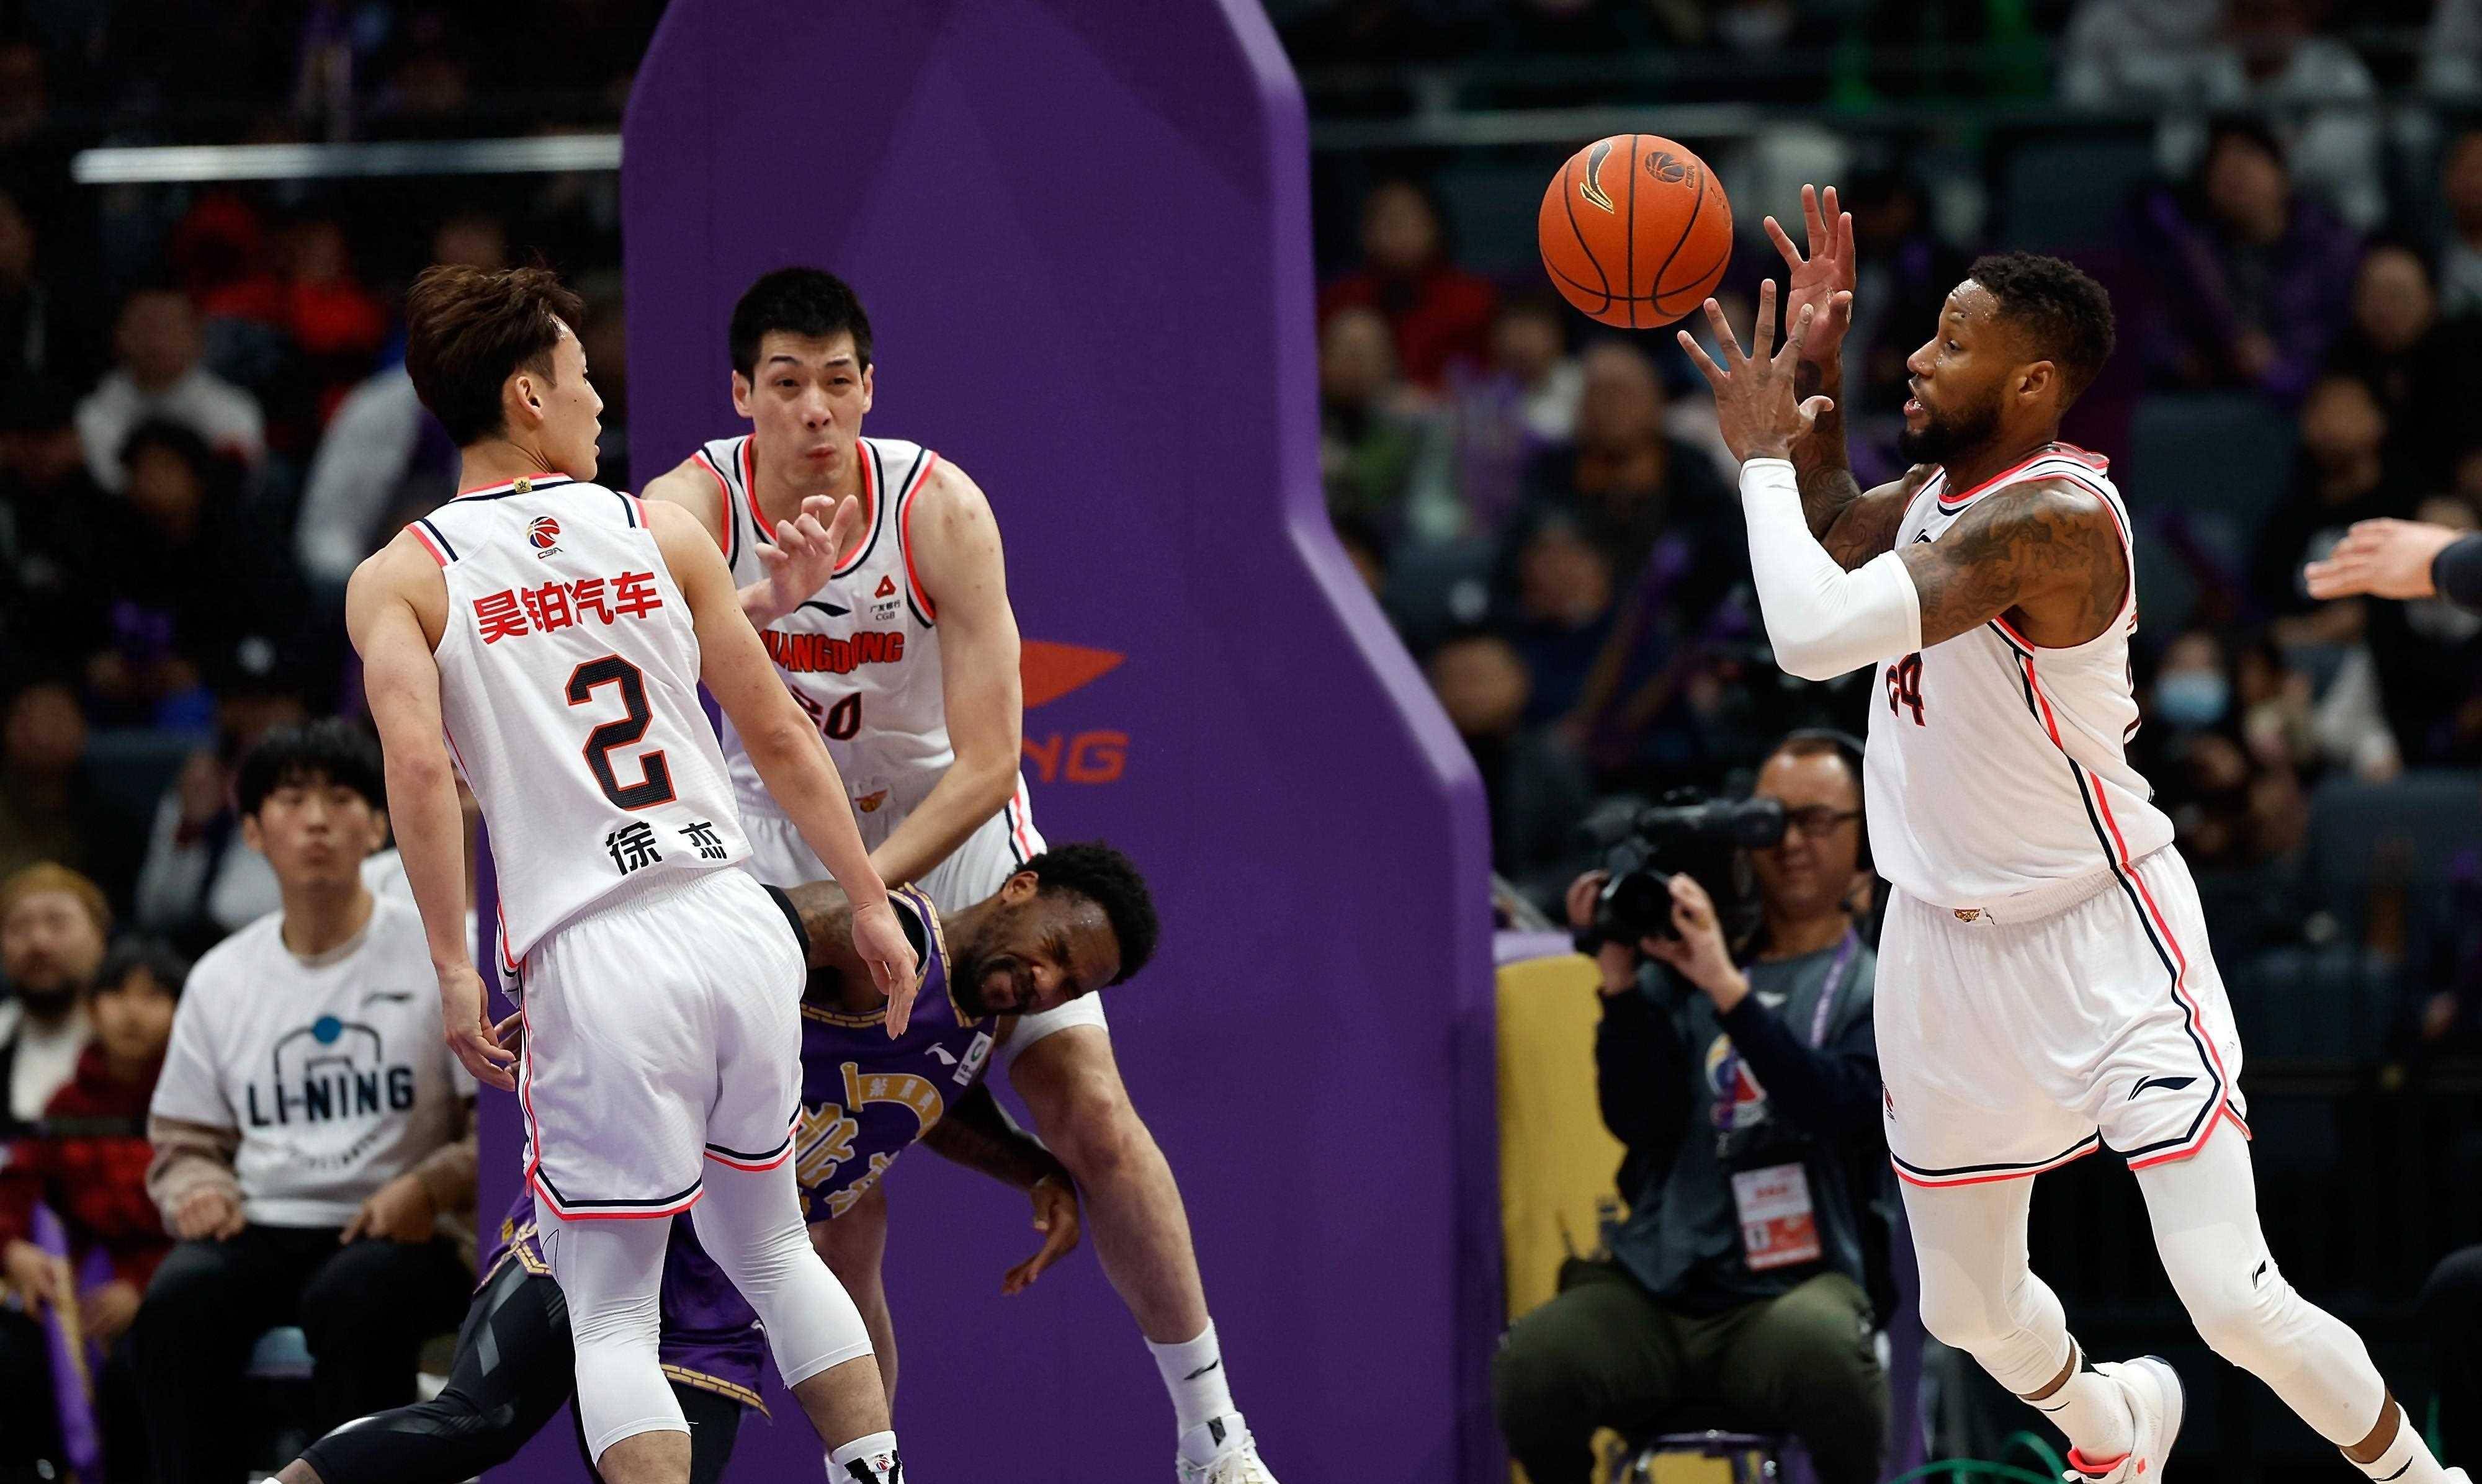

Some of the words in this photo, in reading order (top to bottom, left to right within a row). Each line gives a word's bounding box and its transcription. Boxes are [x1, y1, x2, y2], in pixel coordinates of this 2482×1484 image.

[472, 571, 664, 645] 昊铂汽车
[876, 611, 895, 621] CGB
[761, 630, 904, 674] UANGDONG
[565, 653, 677, 811] 2
[247, 1067, 416, 1127] LI-NING
